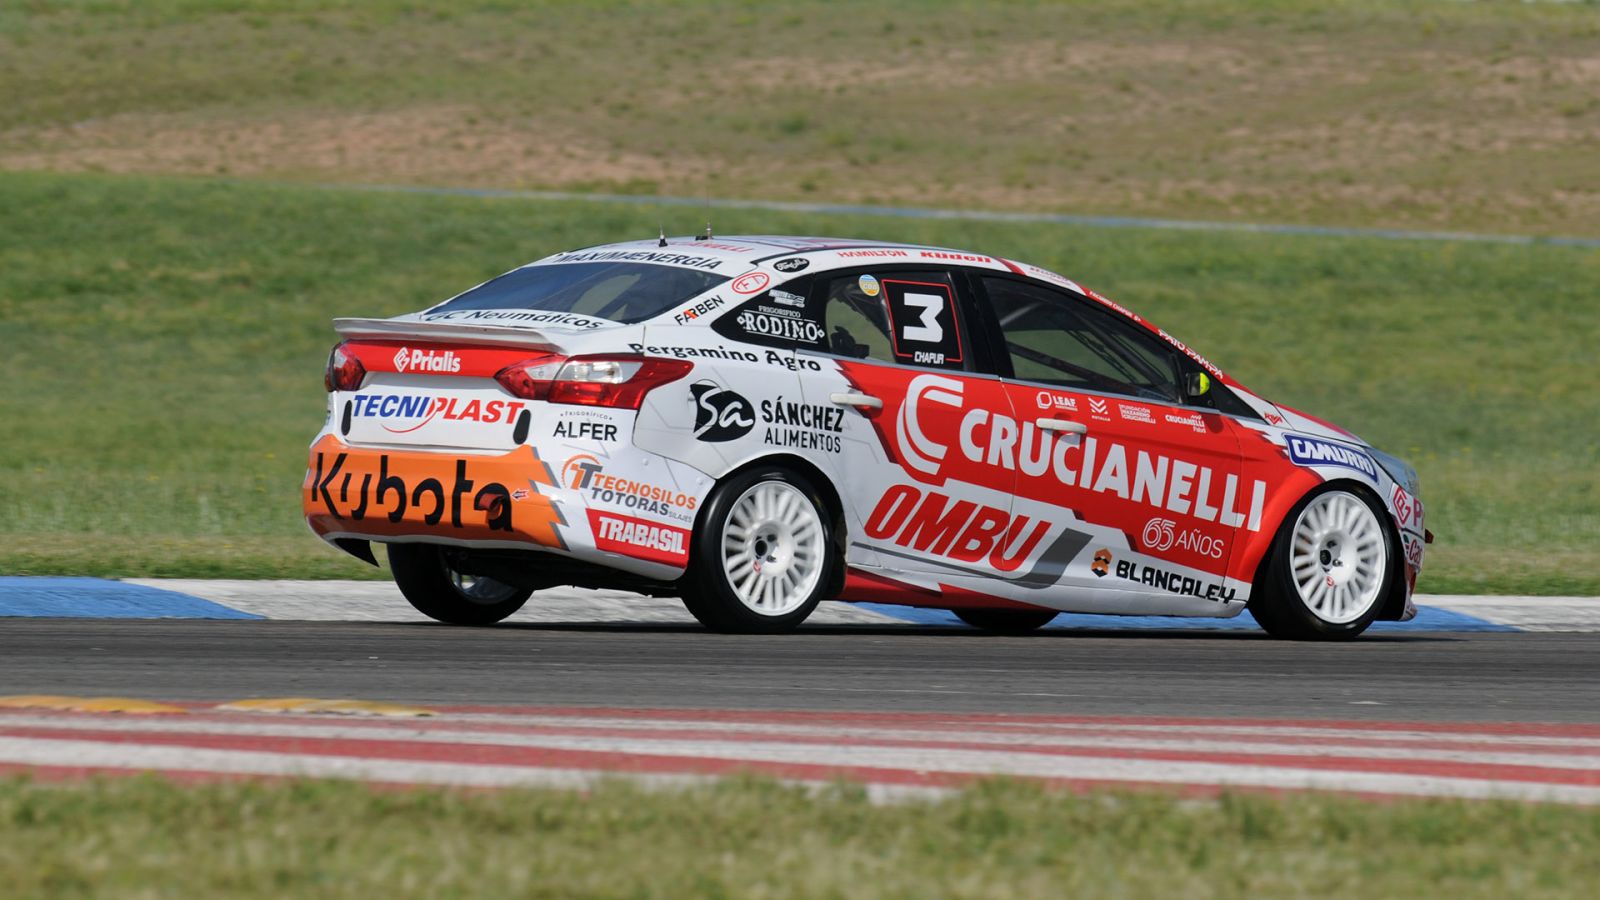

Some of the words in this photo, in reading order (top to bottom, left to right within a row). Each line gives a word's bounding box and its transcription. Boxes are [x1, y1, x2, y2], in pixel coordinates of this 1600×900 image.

[837, 250, 908, 259] HAMILTON
[464, 310, 604, 329] Neumáticos
[674, 295, 725, 326] FARBEN
[903, 292, 944, 343] 3
[410, 349, 461, 373] Prialis
[628, 343, 759, 363] Pergamino
[764, 350, 822, 371] Agro
[914, 350, 945, 365] CHAPUR
[353, 394, 525, 425] TECNIPLAST
[761, 396, 845, 432] SÁNCHEZ
[1052, 395, 1076, 407] LEAF
[553, 421, 618, 442] ALFER
[1165, 414, 1205, 427] CRUCIANELLI
[764, 427, 842, 454] ALIMENTOS
[959, 408, 1266, 532] CRUCIANELLI
[311, 452, 514, 533] Kubota
[592, 487, 670, 516] TOTORAS
[594, 473, 697, 510] TECNOSILOS
[598, 516, 686, 555] TRABASIL
[864, 484, 1052, 572] OMBU
[1142, 517, 1176, 552] 65
[1175, 529, 1225, 559] AÑOS
[1116, 559, 1236, 604] BLANCALEY
